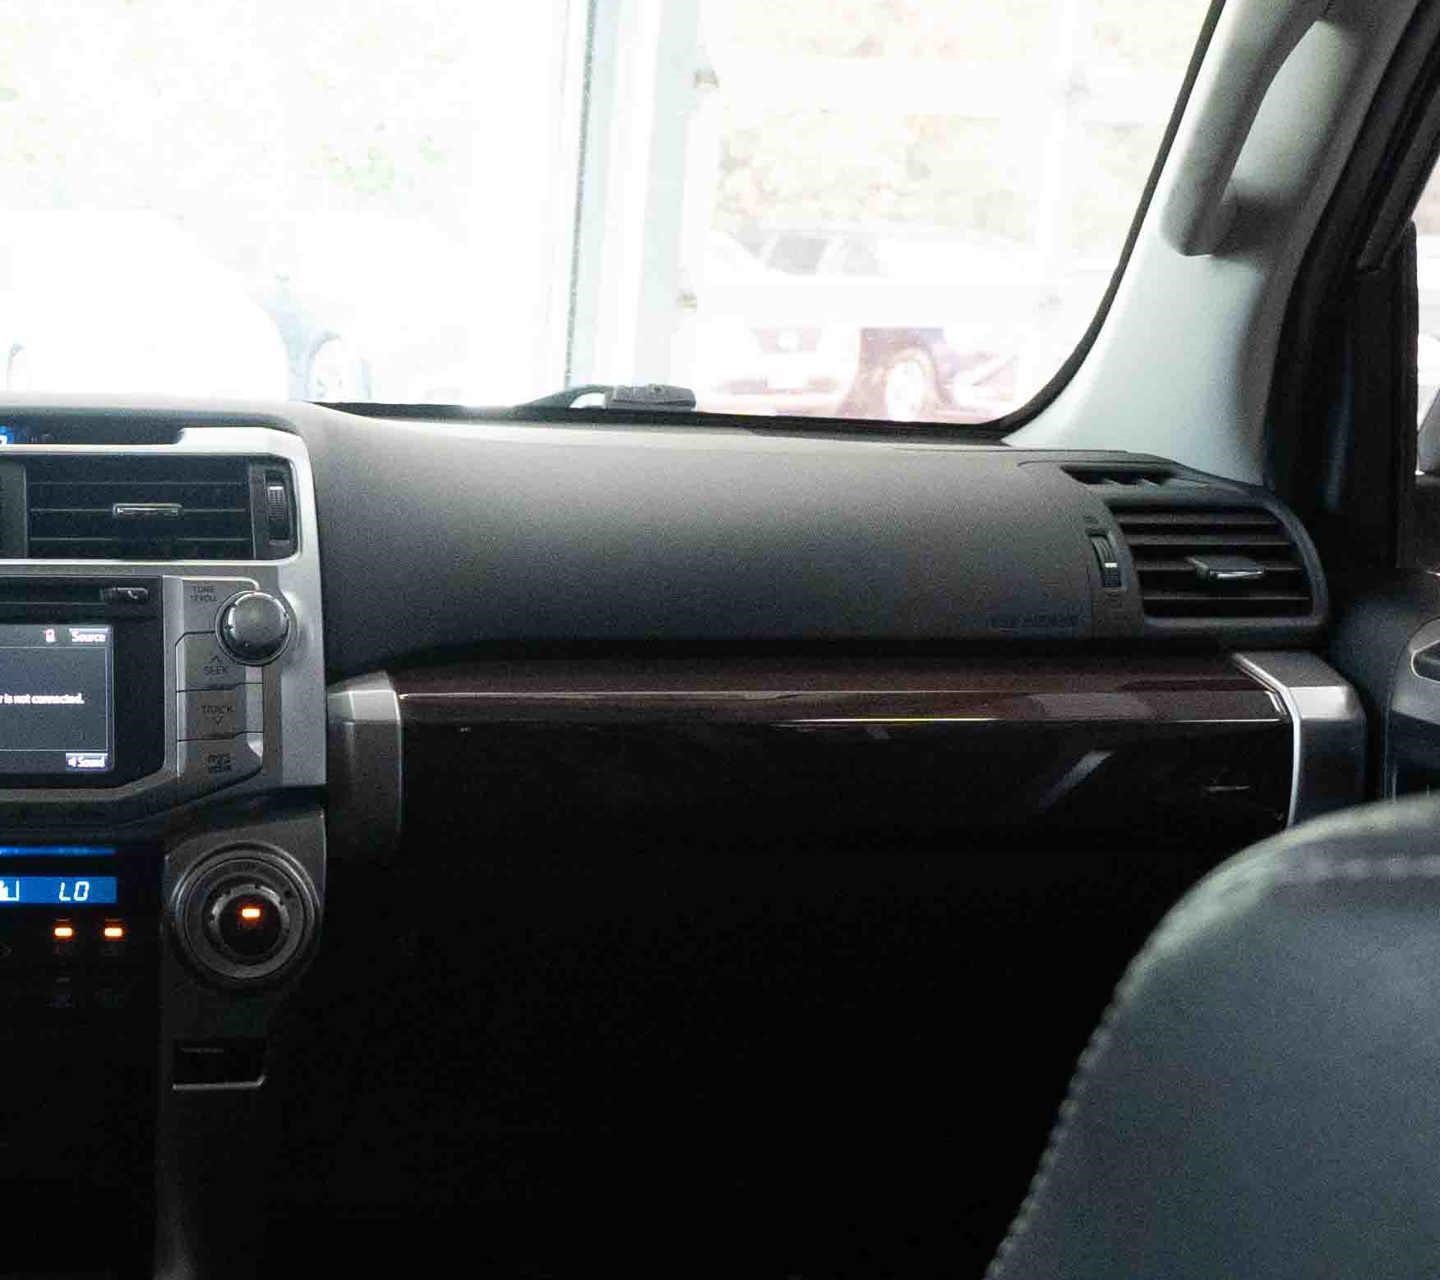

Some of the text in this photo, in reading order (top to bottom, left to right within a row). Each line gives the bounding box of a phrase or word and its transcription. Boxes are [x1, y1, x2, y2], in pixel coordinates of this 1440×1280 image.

[71, 631, 107, 643] Source
[4, 693, 13, 704] is
[13, 694, 31, 704] not
[31, 692, 85, 704] connected.
[75, 754, 106, 768] Sound
[58, 880, 90, 902] LO
